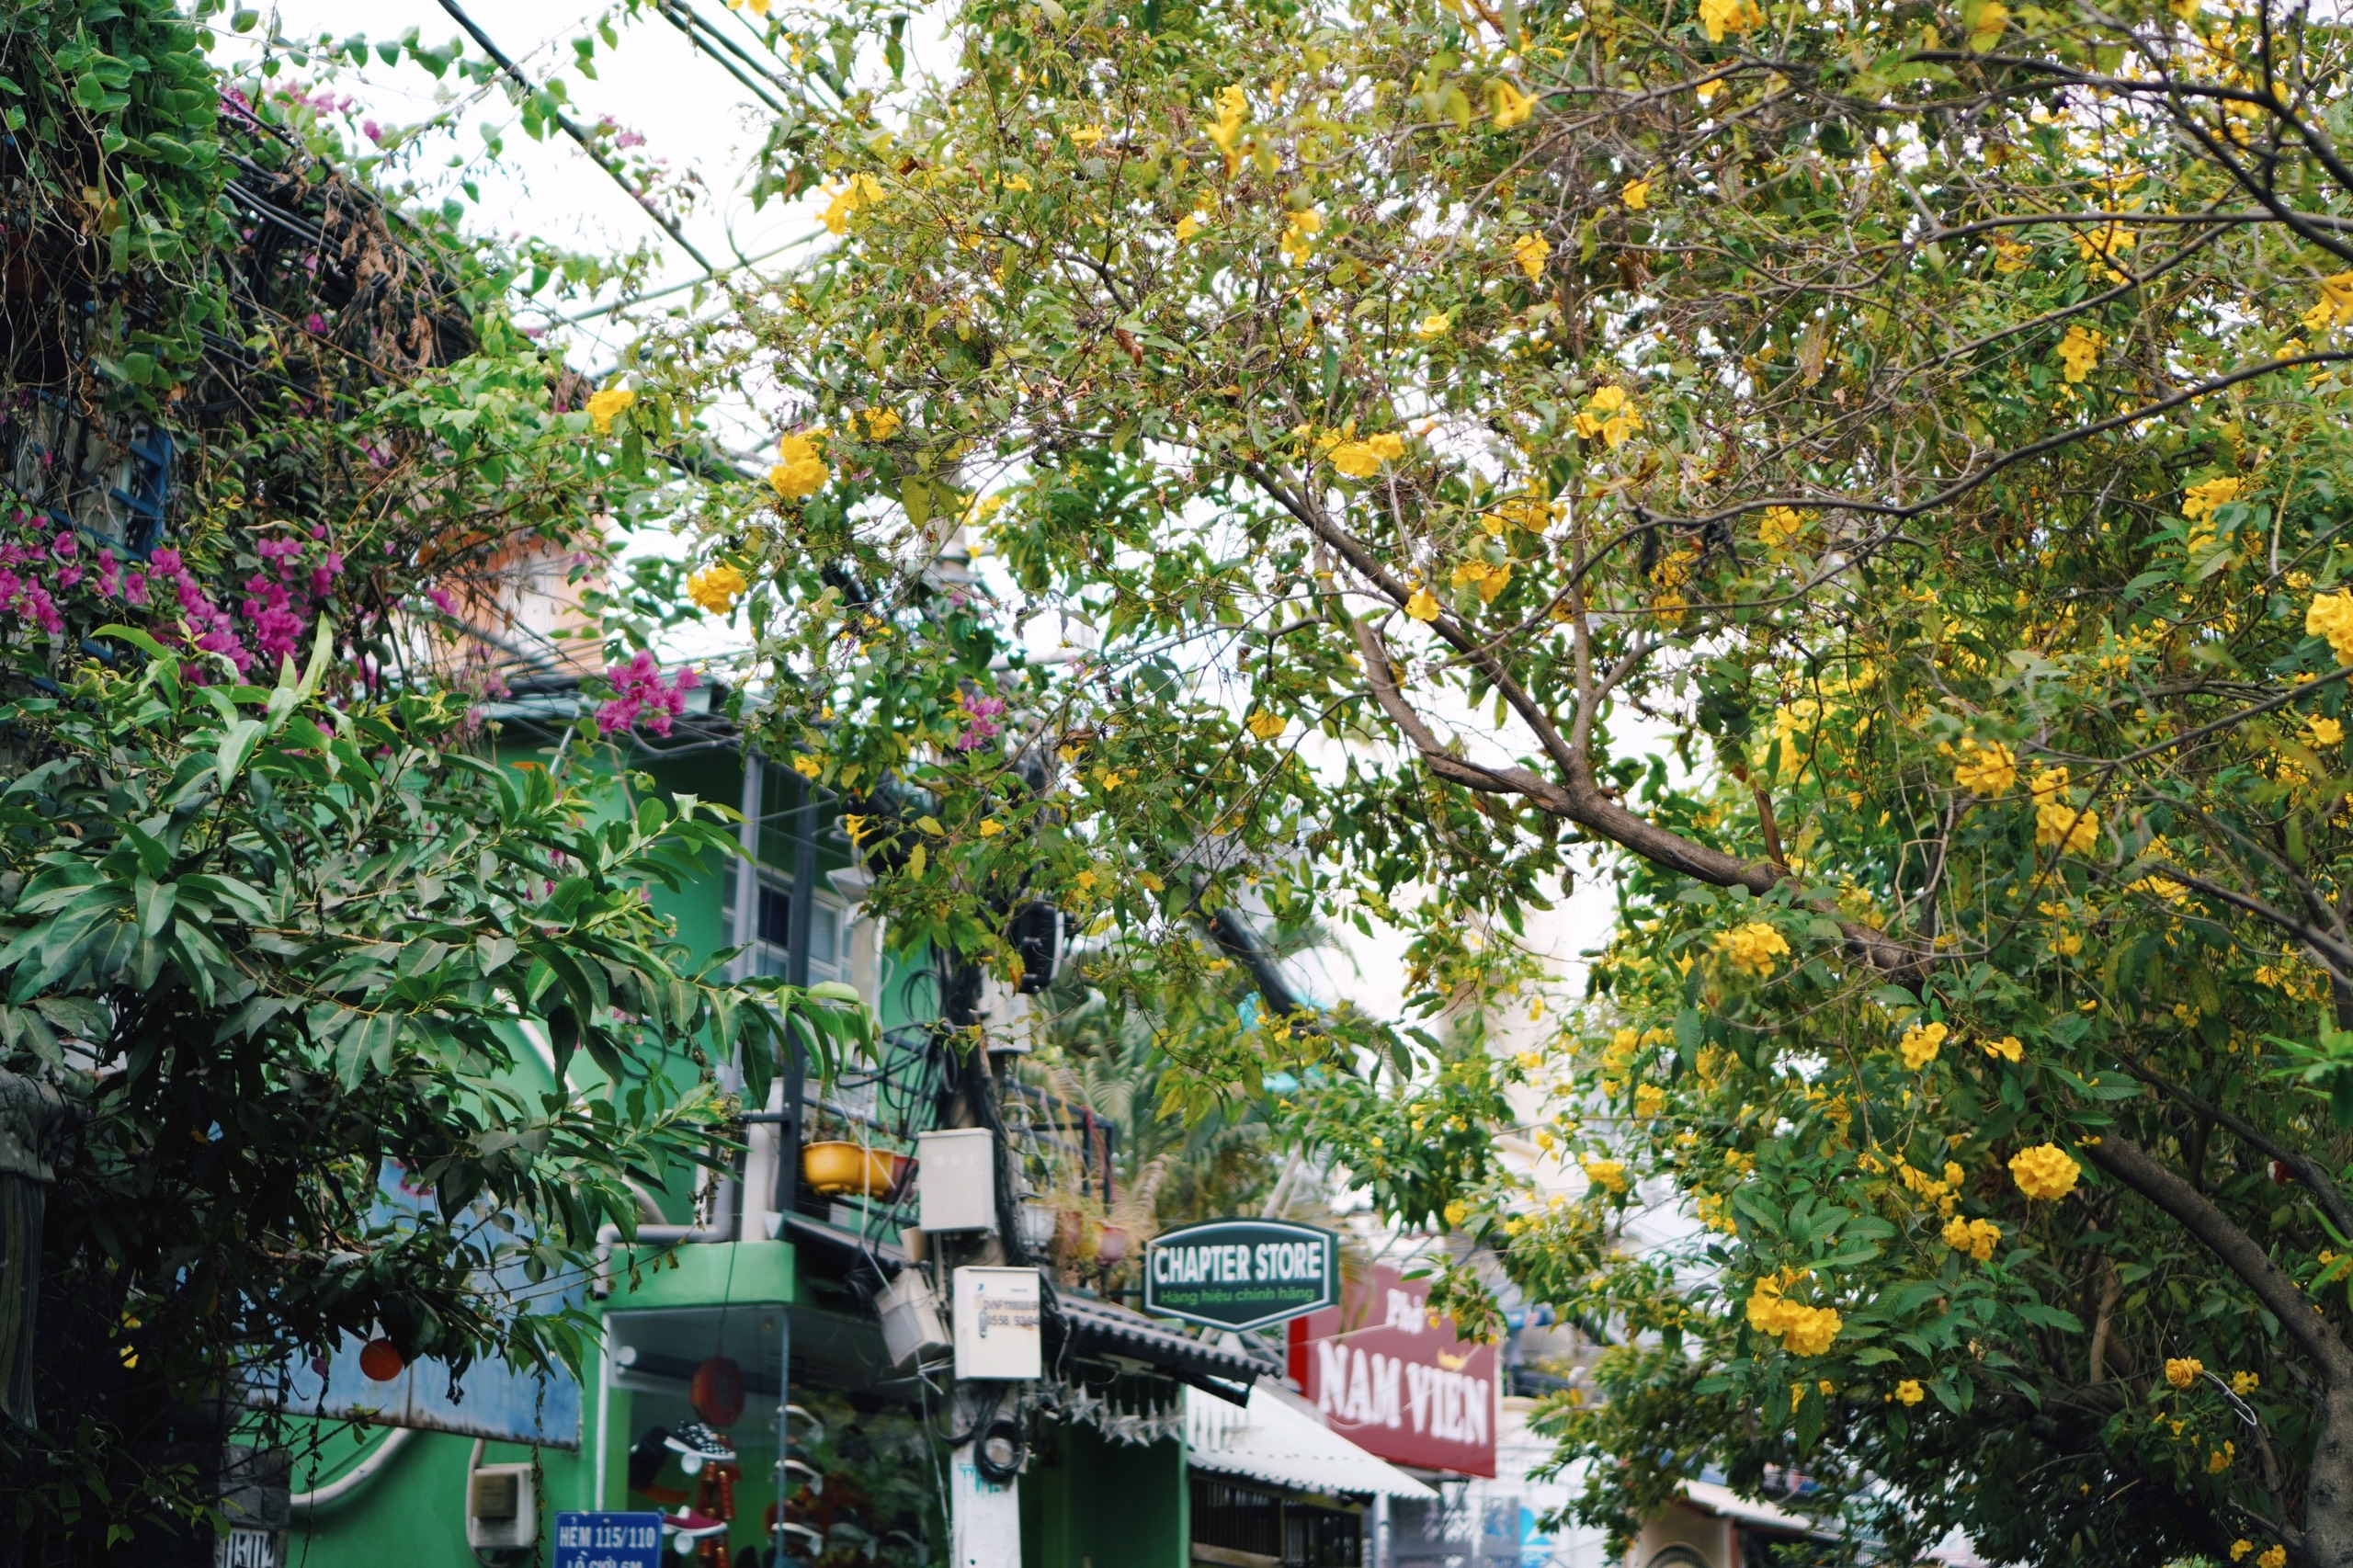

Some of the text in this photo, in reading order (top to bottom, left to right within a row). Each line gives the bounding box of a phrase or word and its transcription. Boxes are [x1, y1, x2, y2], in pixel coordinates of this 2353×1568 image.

[1154, 1241, 1322, 1284] CHAPTER STORE
[1317, 1339, 1402, 1429] NAM
[595, 1527, 656, 1549] 115/110
